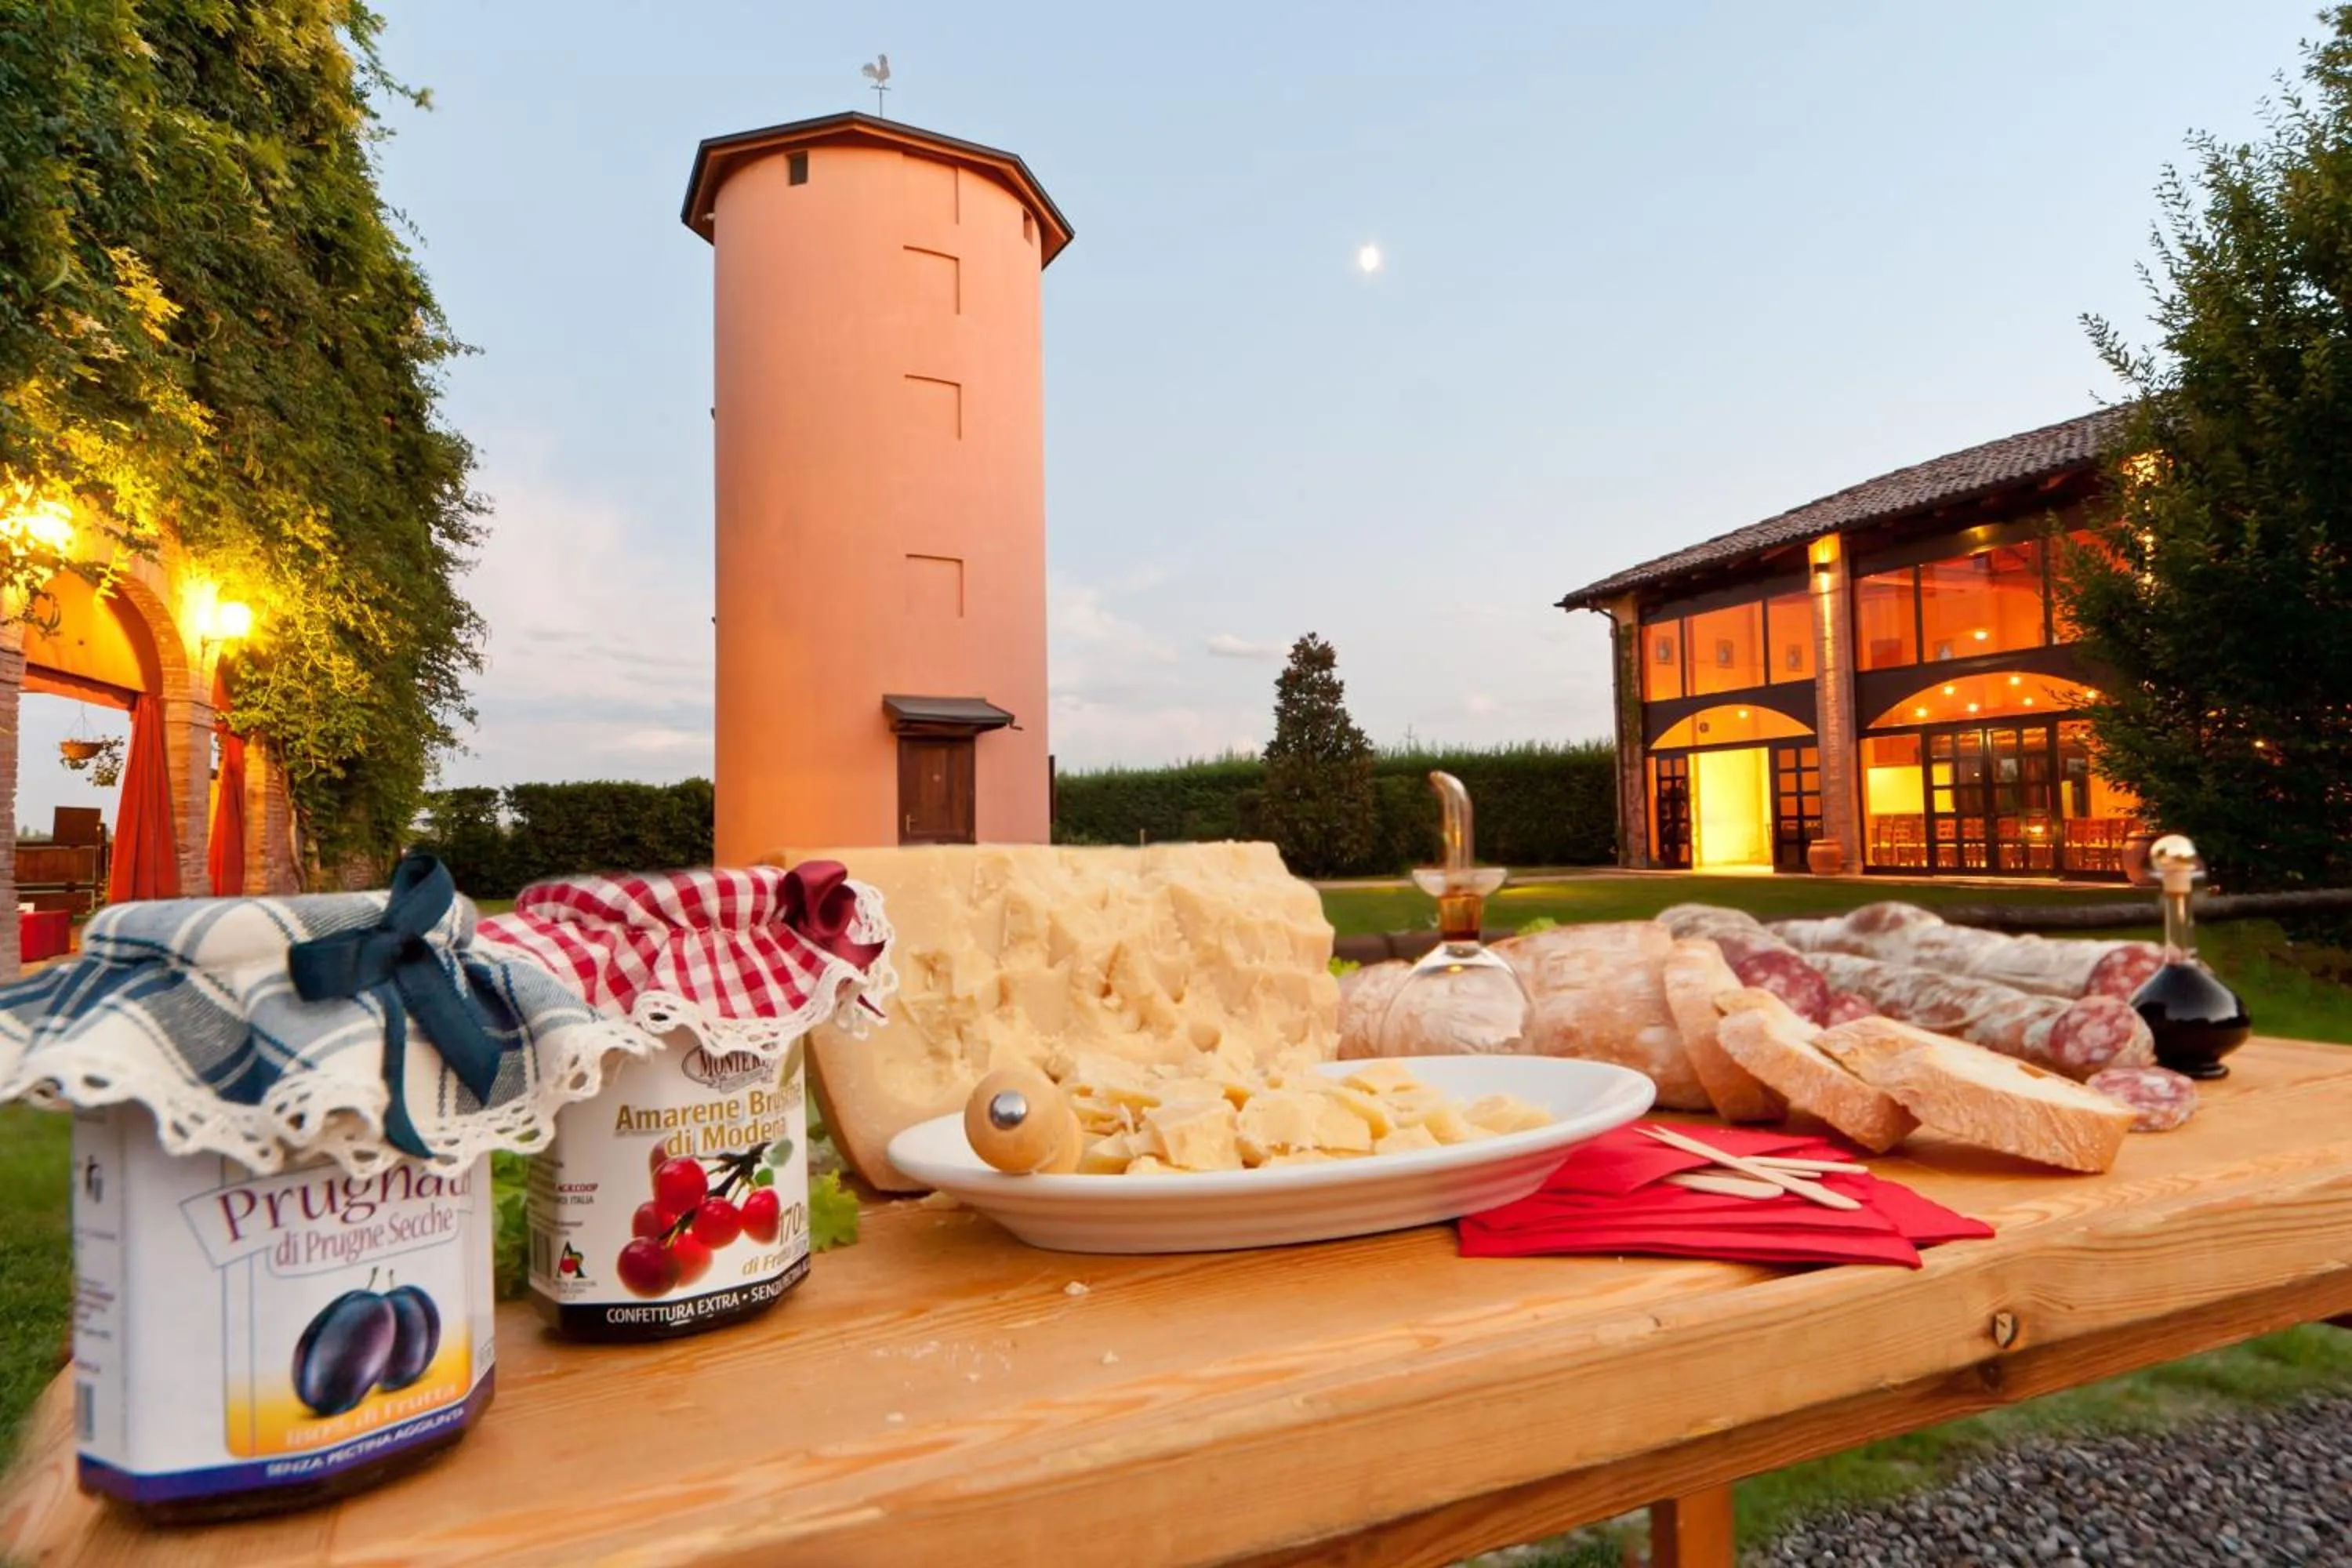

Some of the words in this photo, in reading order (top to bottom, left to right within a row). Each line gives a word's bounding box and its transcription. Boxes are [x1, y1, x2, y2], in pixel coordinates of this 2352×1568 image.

[615, 1098, 740, 1131] Amarene
[666, 1129, 691, 1156] di
[276, 1232, 299, 1266] di
[305, 1223, 385, 1262] Prugne
[388, 1203, 453, 1243] Secche
[606, 1303, 695, 1324] CONFETTURA
[697, 1292, 739, 1316] EXTRA
[266, 1457, 325, 1478] SENZA
